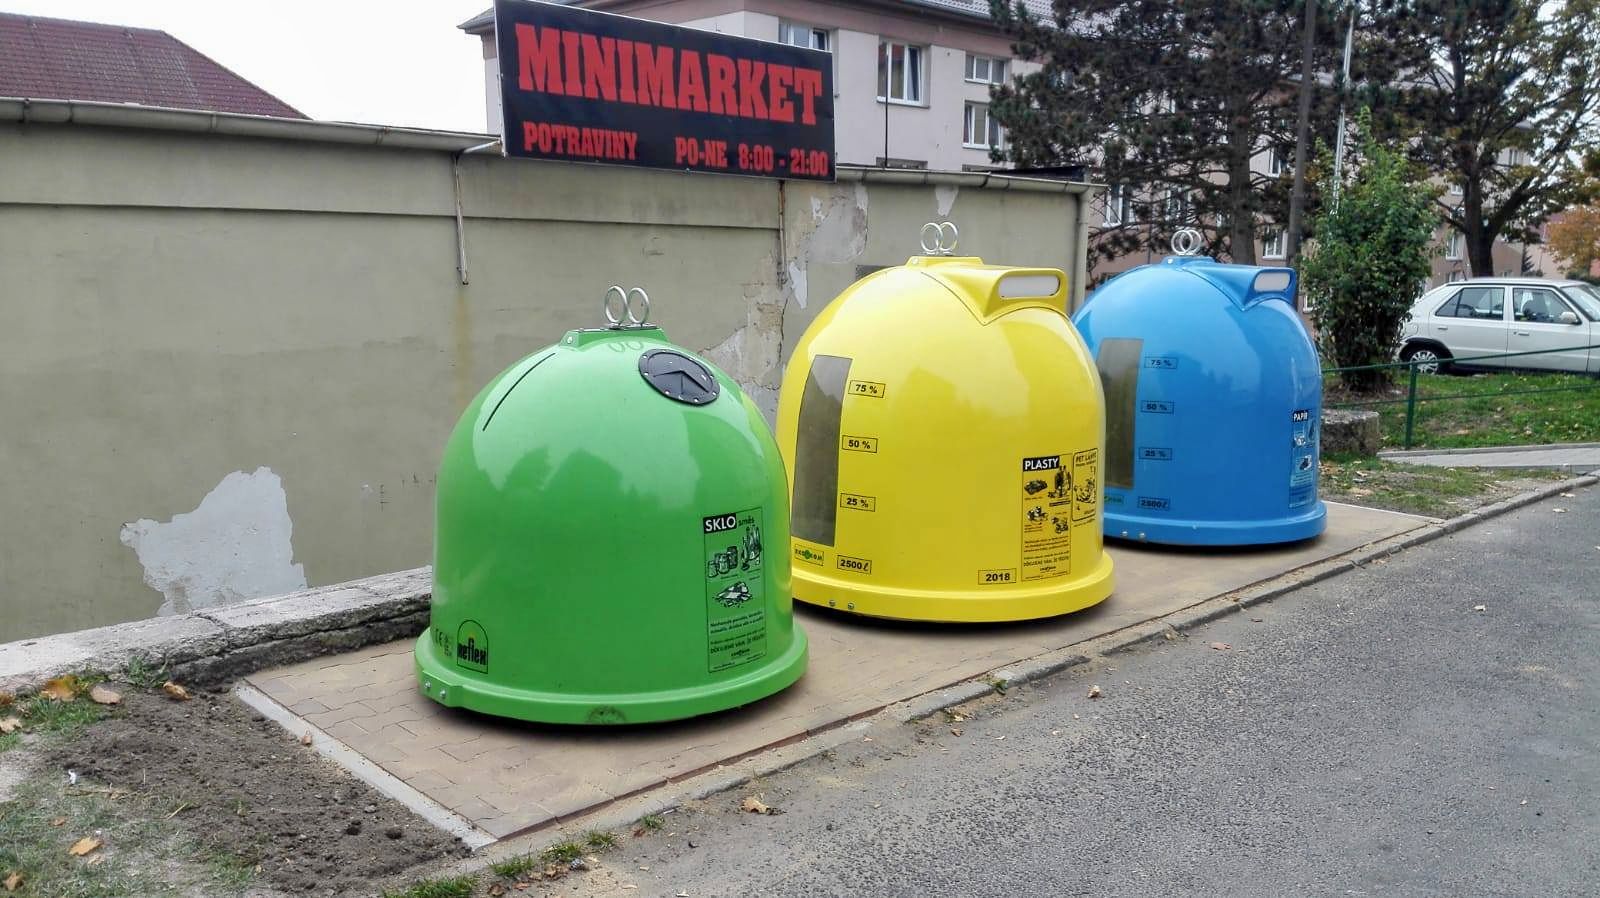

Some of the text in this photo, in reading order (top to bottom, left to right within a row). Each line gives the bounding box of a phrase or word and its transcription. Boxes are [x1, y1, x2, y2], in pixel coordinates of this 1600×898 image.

[515, 23, 822, 126] MINIMARKET
[523, 121, 638, 161] POTRAVINY
[675, 137, 728, 168] PO-NE
[738, 143, 775, 172] 8:00
[790, 148, 829, 177] 21:00
[855, 383, 878, 394] 75 %
[848, 439, 871, 450] 50 %
[1024, 457, 1059, 470] PLASTY
[846, 497, 869, 508] 25 %
[705, 515, 736, 532] SKLO
[985, 573, 1010, 582] 2018
